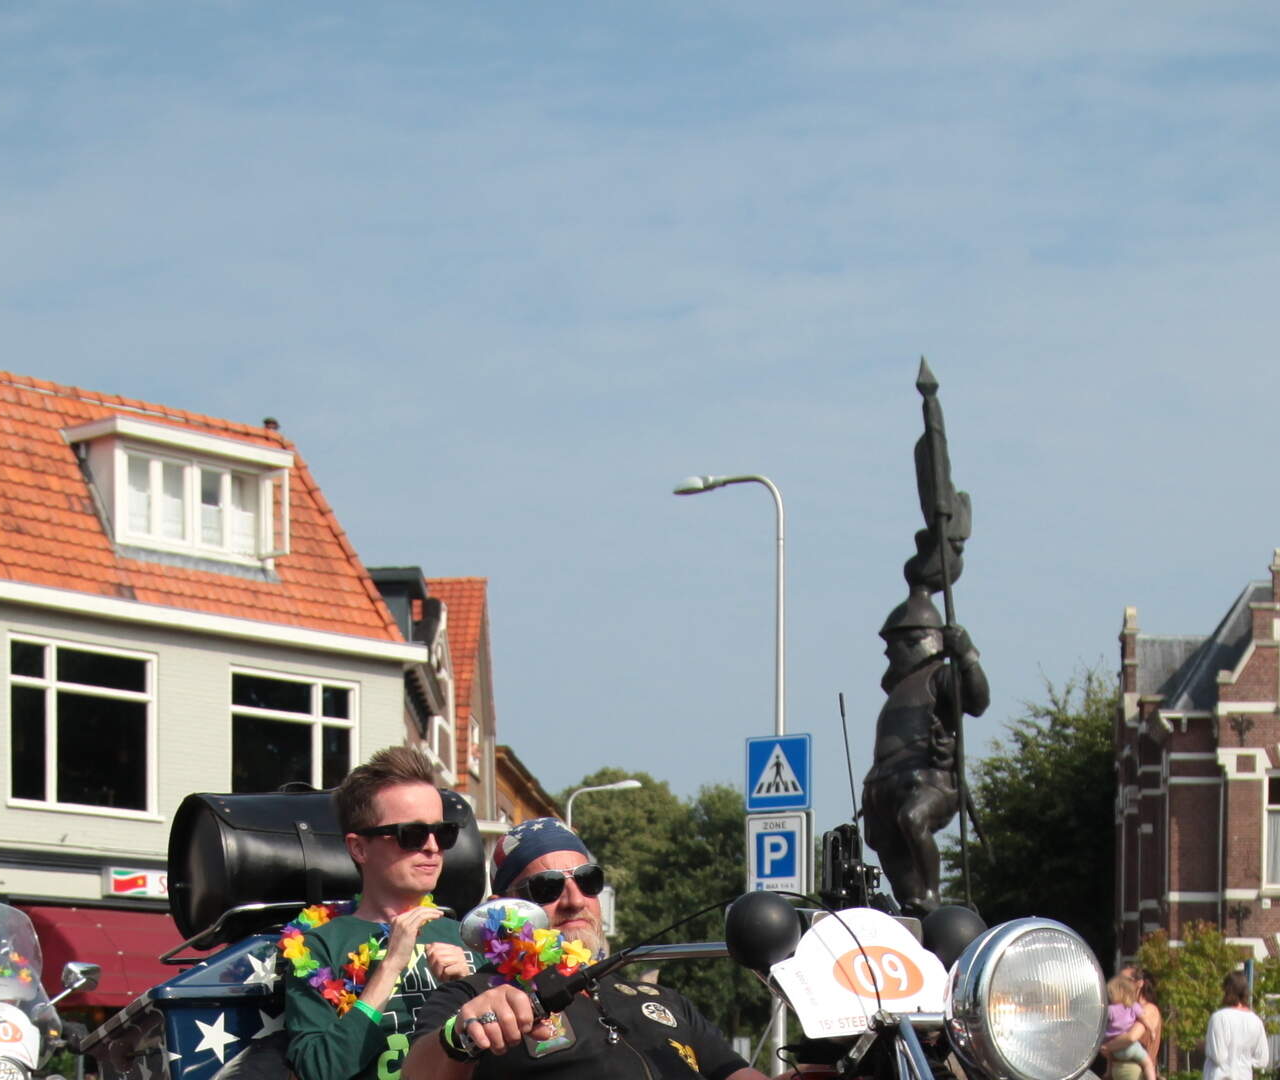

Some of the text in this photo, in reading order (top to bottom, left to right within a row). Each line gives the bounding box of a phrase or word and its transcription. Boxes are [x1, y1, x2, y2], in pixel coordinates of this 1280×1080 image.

[762, 820, 787, 831] ZONE
[764, 835, 788, 875] P
[853, 952, 909, 993] 09
